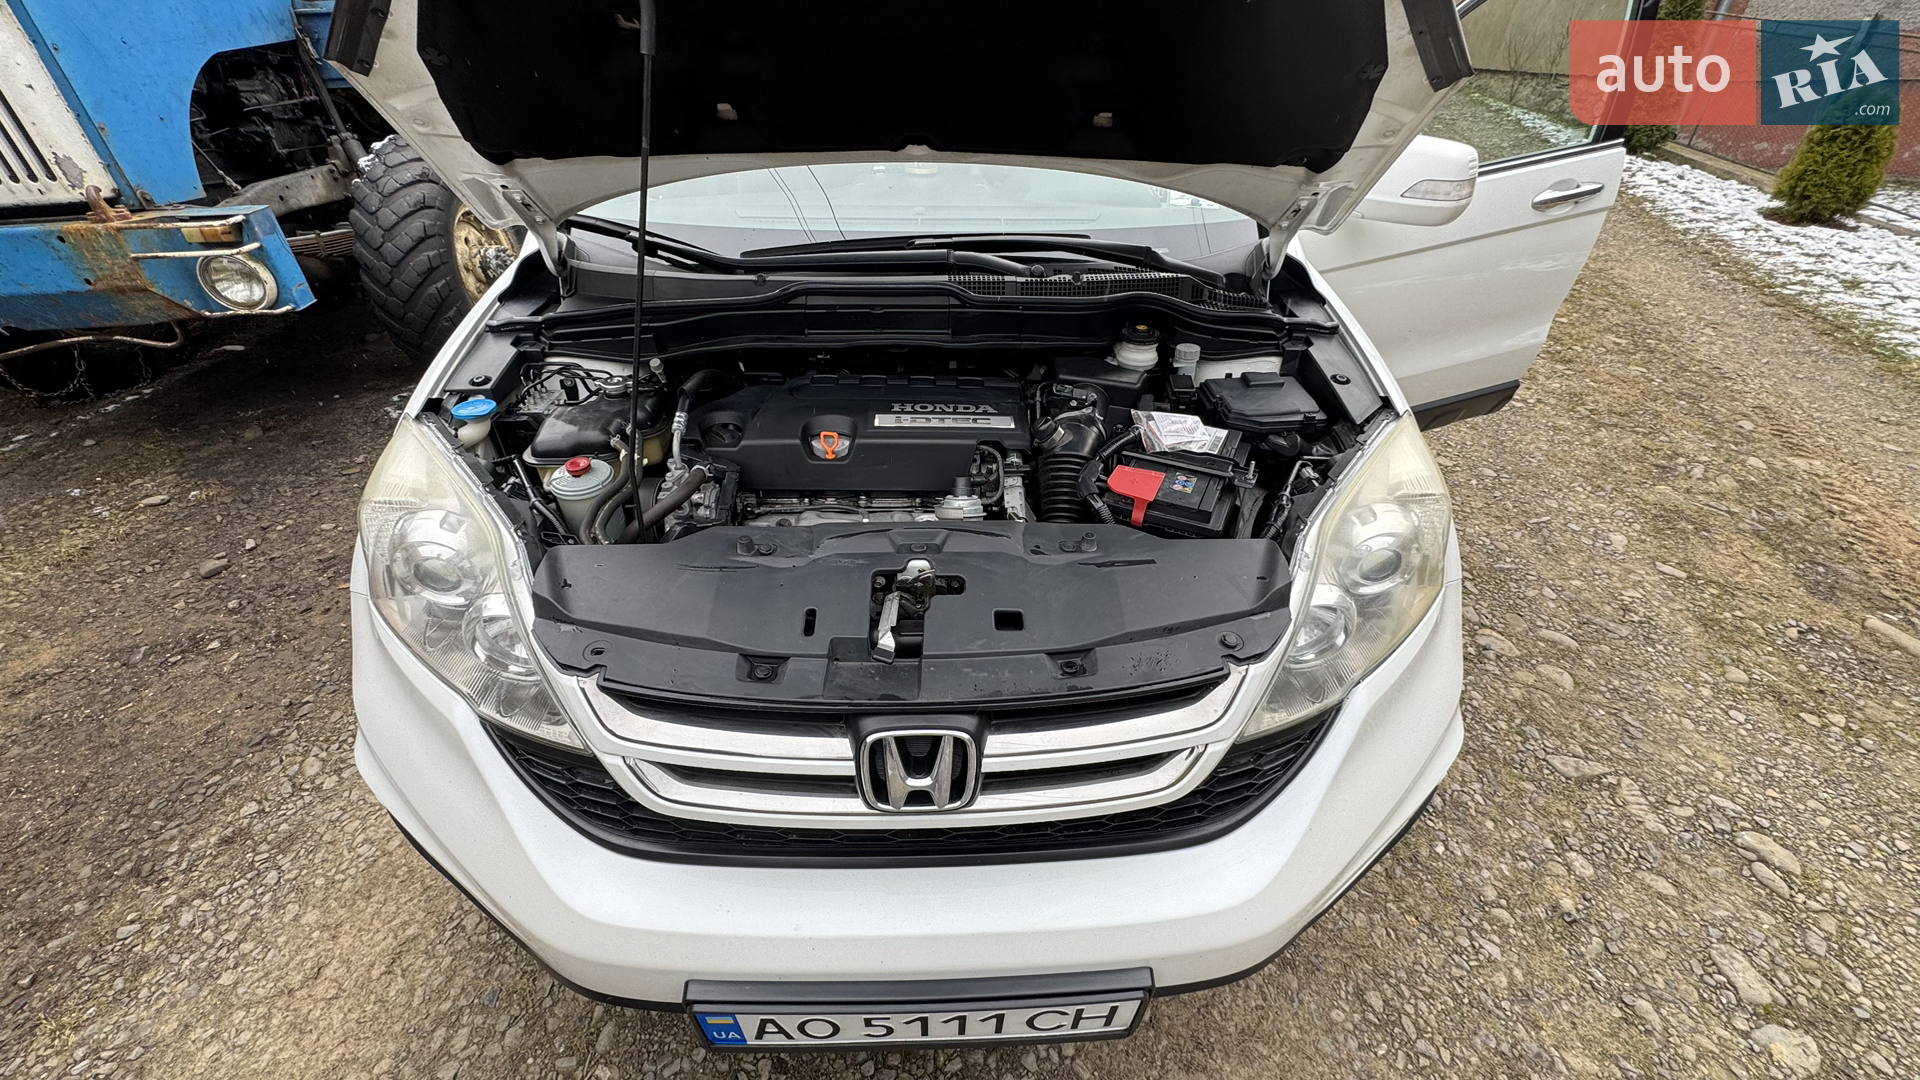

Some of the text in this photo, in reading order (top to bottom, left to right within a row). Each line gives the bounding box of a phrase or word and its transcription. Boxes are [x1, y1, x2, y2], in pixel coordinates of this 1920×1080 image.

[891, 403, 998, 413] HONDA
[754, 1005, 1119, 1040] AO 5111 CH
[712, 1031, 742, 1039] UA
